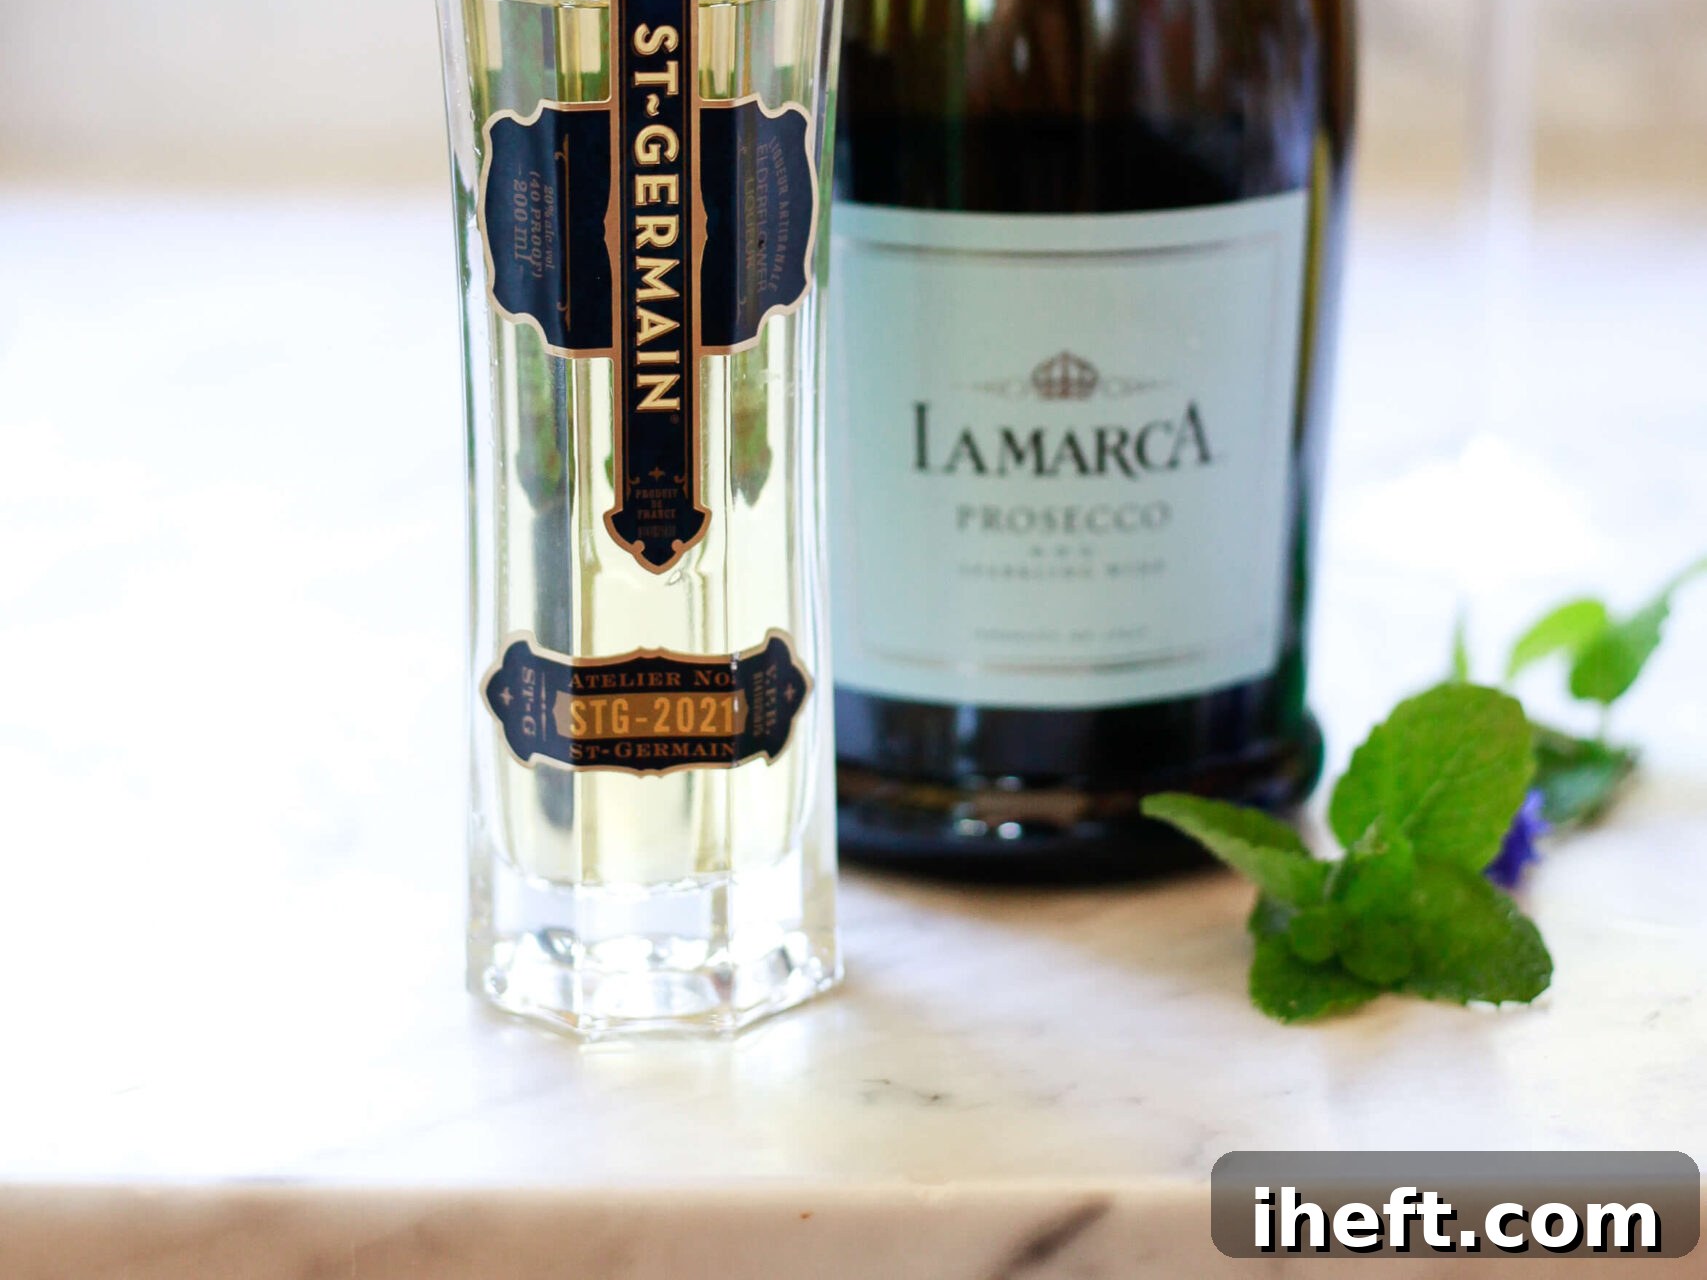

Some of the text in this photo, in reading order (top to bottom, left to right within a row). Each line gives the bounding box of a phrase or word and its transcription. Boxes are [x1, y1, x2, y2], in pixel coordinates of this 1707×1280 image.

[513, 178, 528, 222] 200
[956, 499, 1173, 535] PROSECCO
[568, 671, 681, 690] ATELIER
[570, 696, 733, 737] STG-2021
